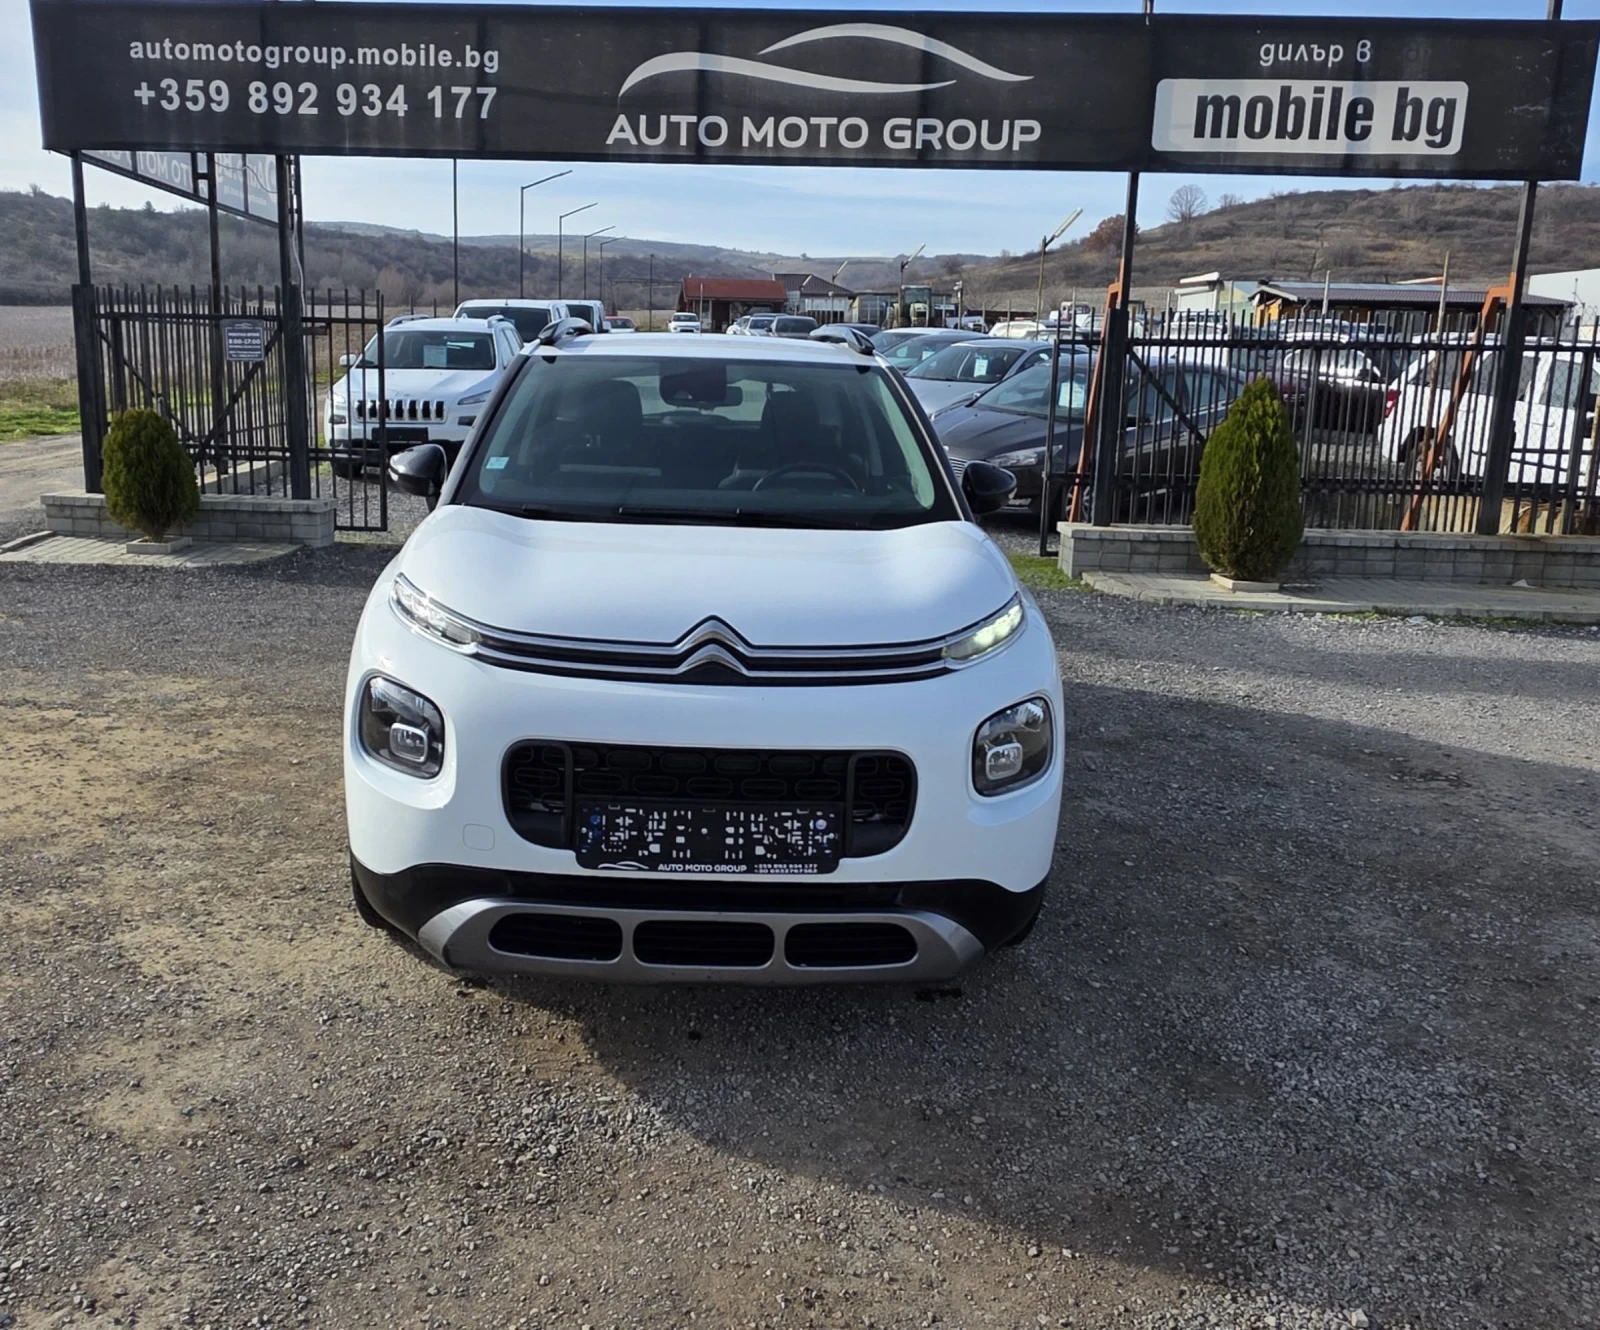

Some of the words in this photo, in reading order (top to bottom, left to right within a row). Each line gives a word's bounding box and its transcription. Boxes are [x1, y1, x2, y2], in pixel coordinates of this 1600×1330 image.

[129, 37, 499, 73] automotogroup.mobile.bg
[1259, 42, 1344, 68] дилър
[1356, 39, 1372, 63] в
[133, 78, 230, 112] +359
[248, 81, 319, 115] 892
[336, 83, 409, 117] 934
[427, 86, 498, 119] 177
[1193, 85, 1375, 142] mobile
[1391, 87, 1457, 149] bg
[605, 113, 729, 147] AUTO
[741, 116, 869, 149] MOTO
[883, 117, 1042, 151] GROUP
[657, 863, 684, 872] AUTO
[685, 864, 713, 872] MOTO
[714, 864, 748, 873] GROUP
